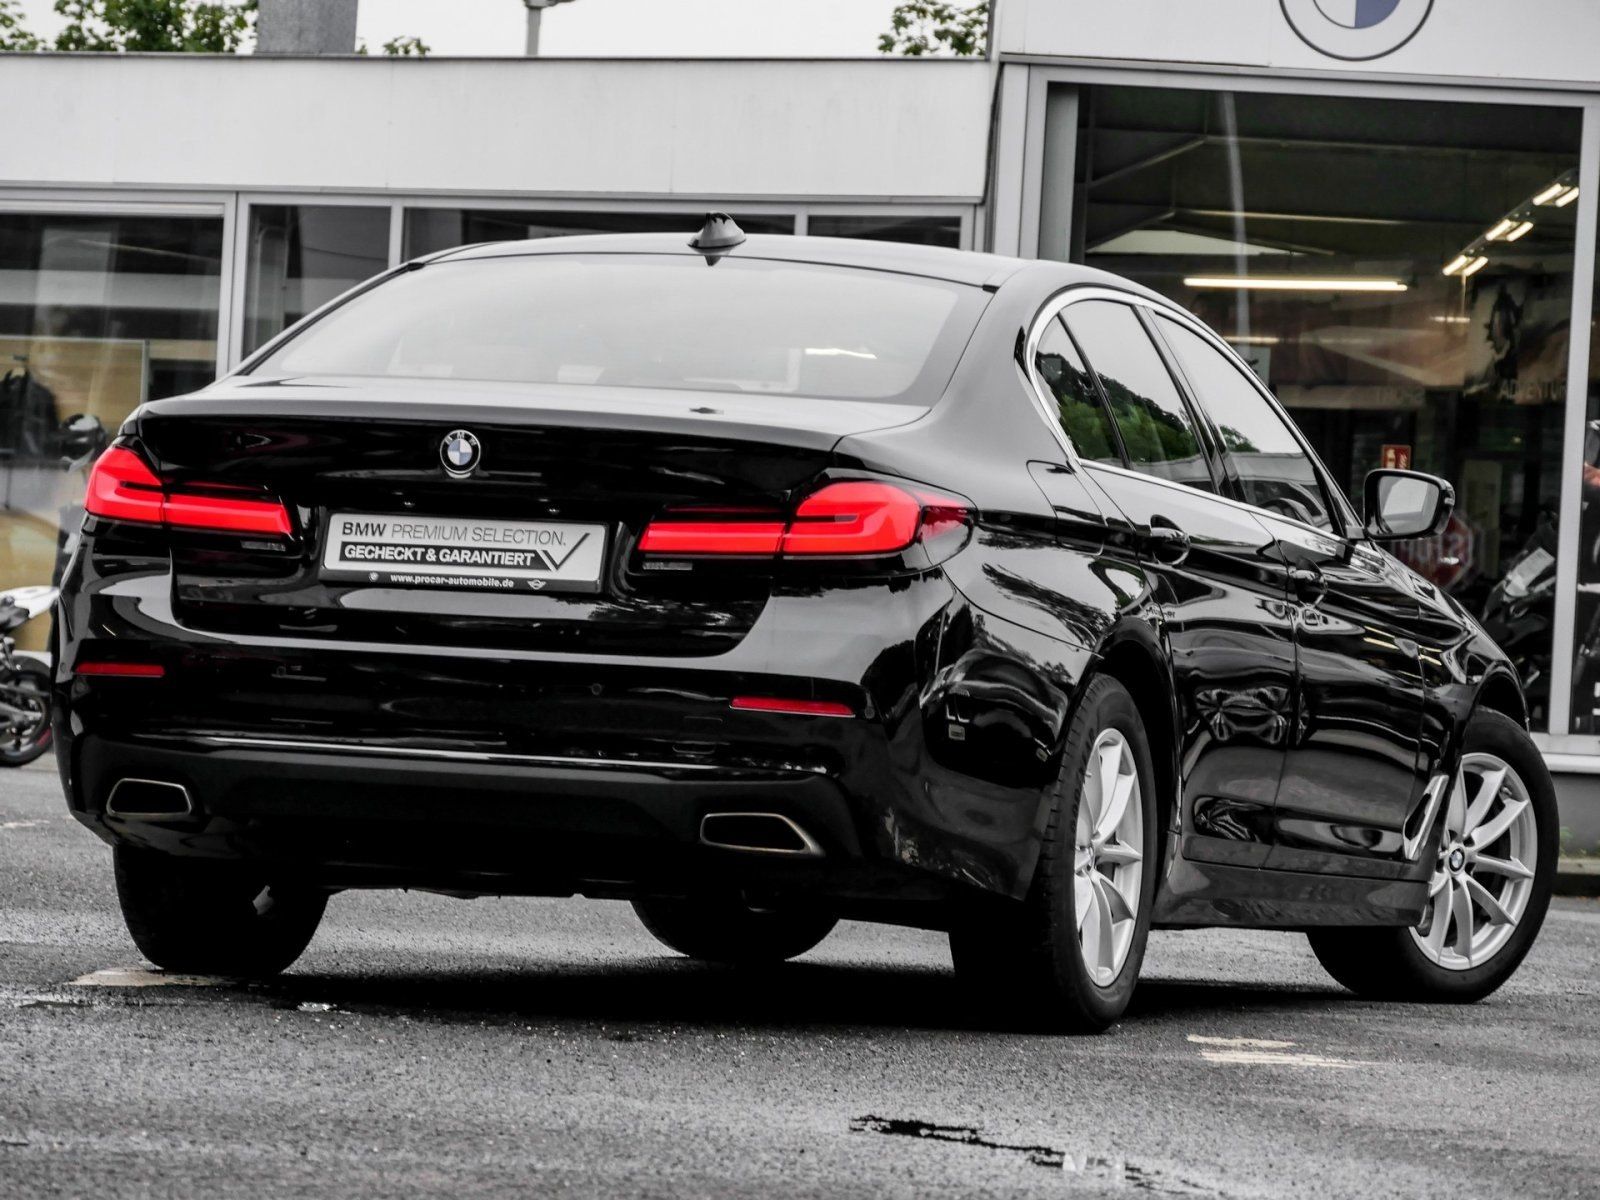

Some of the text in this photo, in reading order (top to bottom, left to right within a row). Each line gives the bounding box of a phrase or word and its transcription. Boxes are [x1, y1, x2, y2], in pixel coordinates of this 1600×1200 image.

[342, 522, 566, 546] BMW PREMIUM SELECTION.
[344, 544, 535, 566] GECHECKT & GARANTIERT
[390, 574, 514, 588] www.procar-automobile.de
